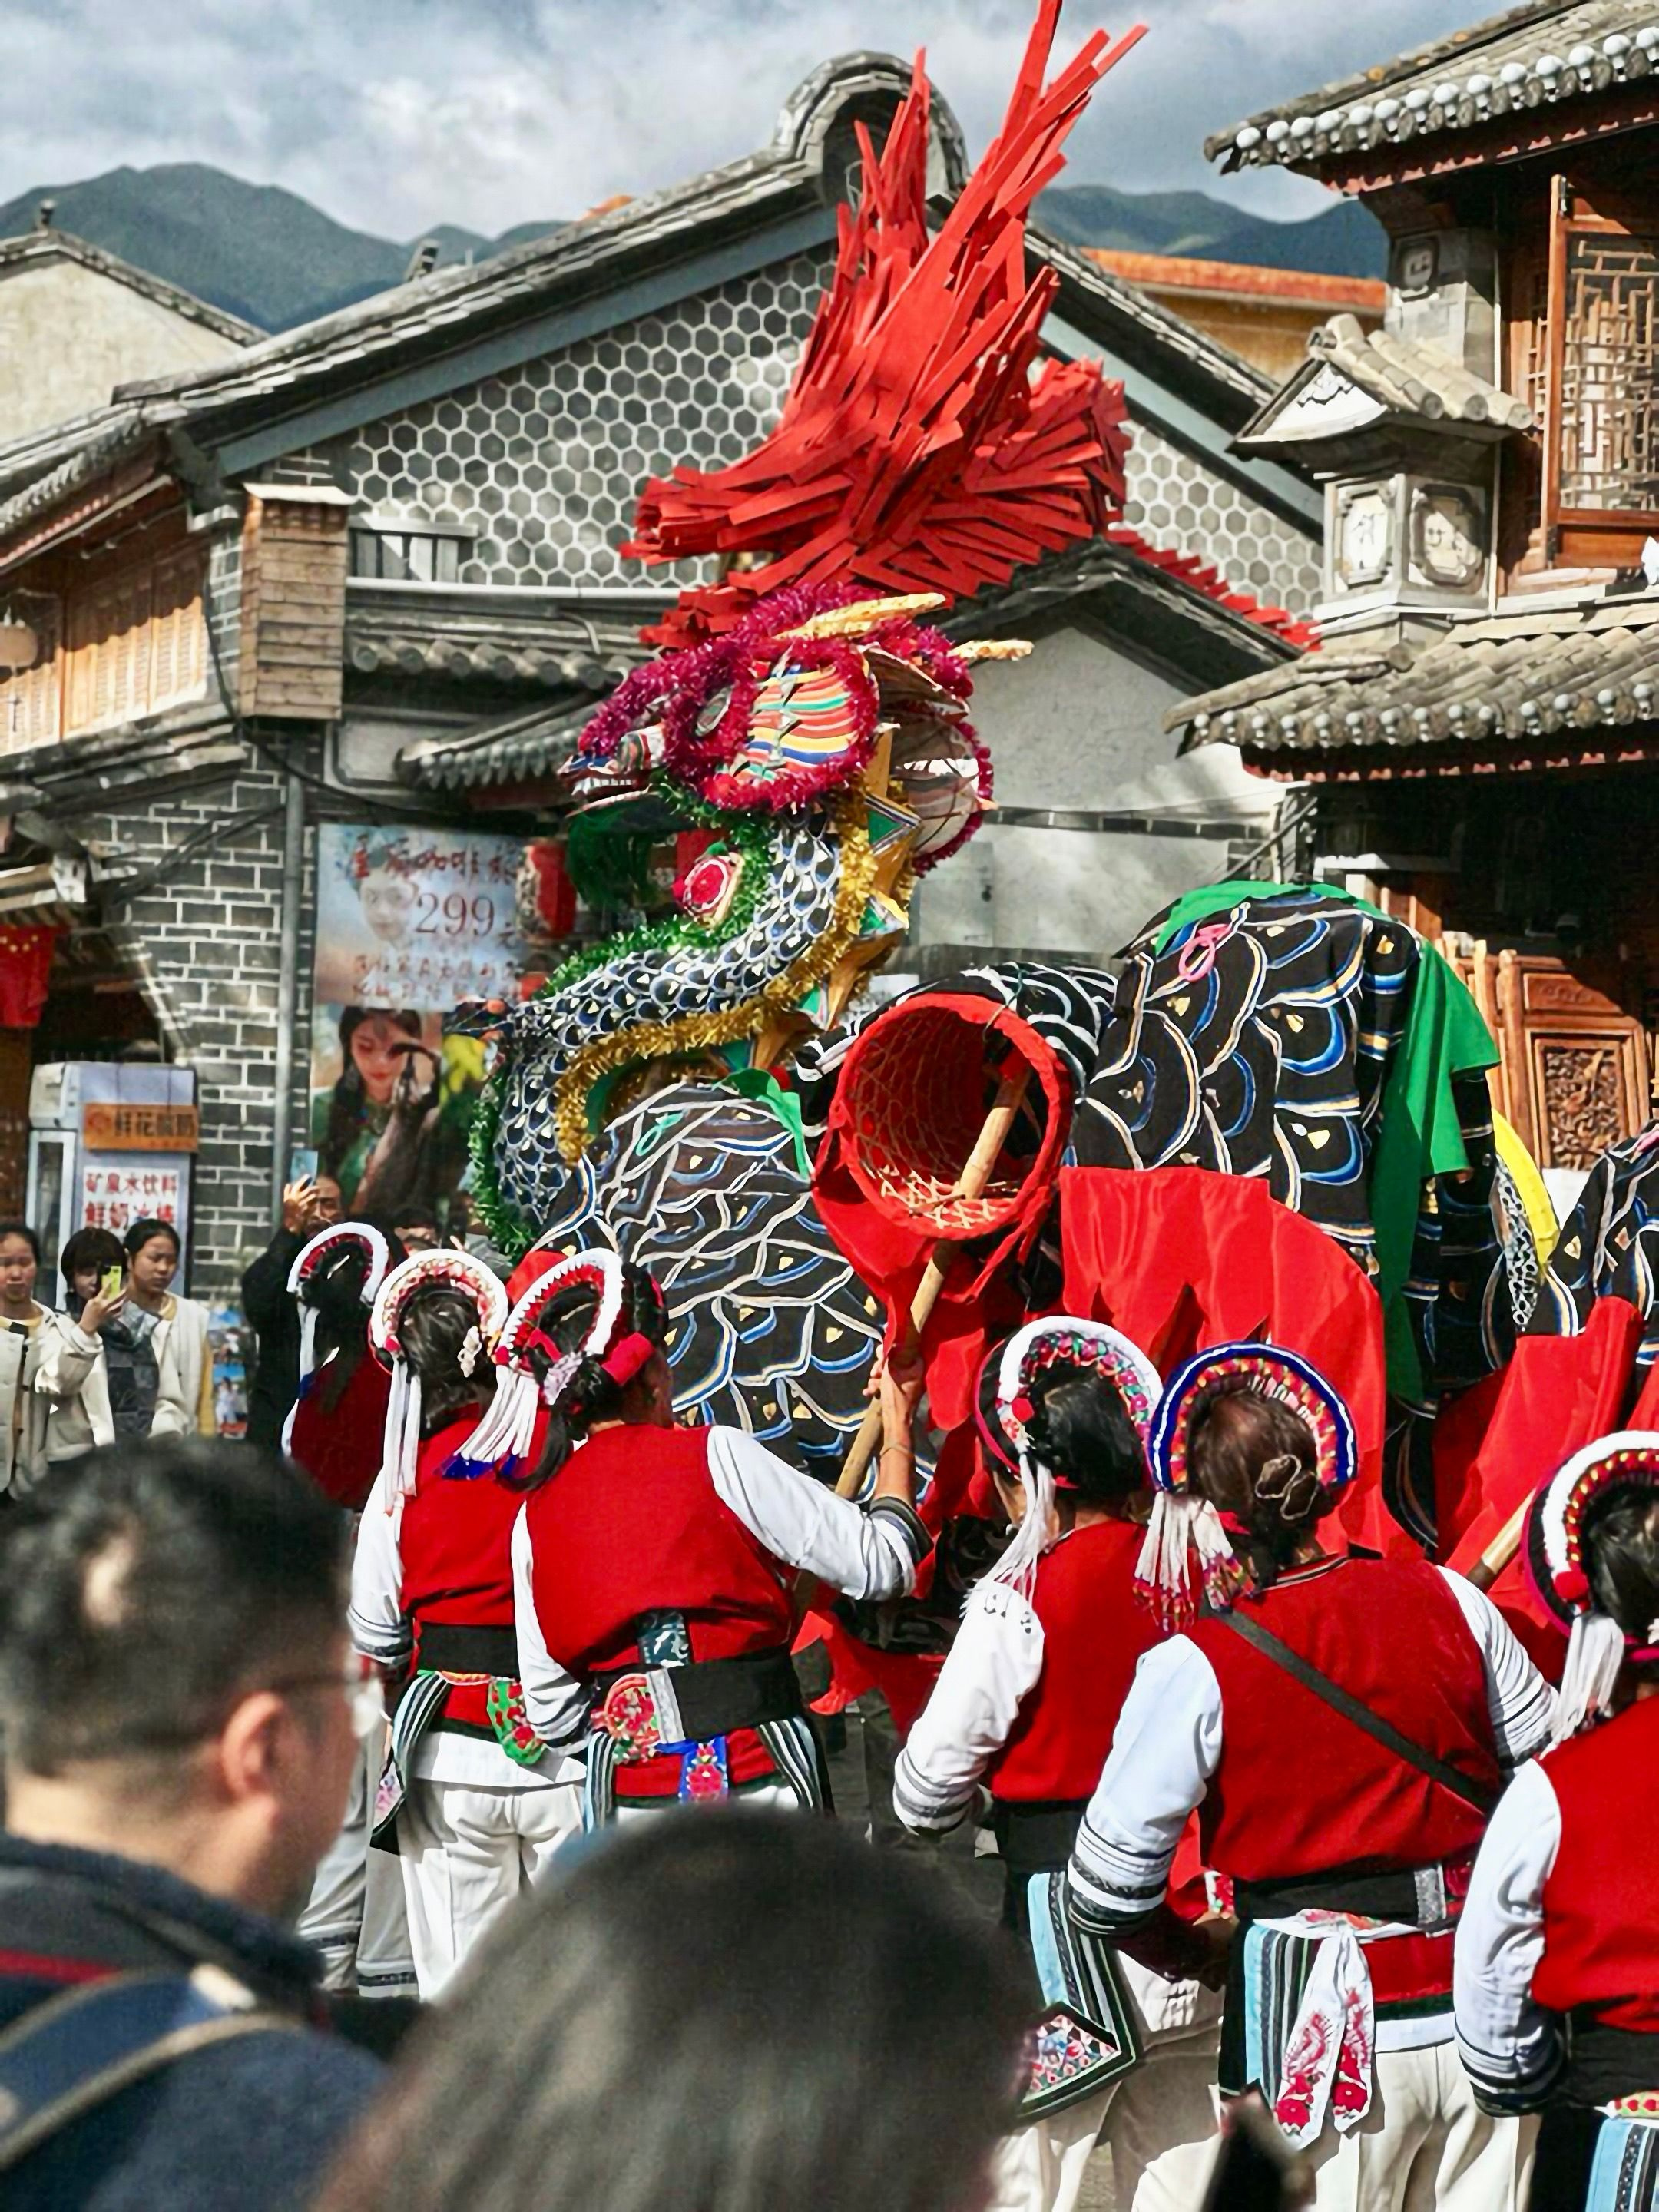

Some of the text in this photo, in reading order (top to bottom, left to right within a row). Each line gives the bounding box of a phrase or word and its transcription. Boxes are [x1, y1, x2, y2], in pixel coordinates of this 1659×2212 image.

[416, 892, 495, 936] 299
[86, 1172, 177, 1196] 矿泉水饮料
